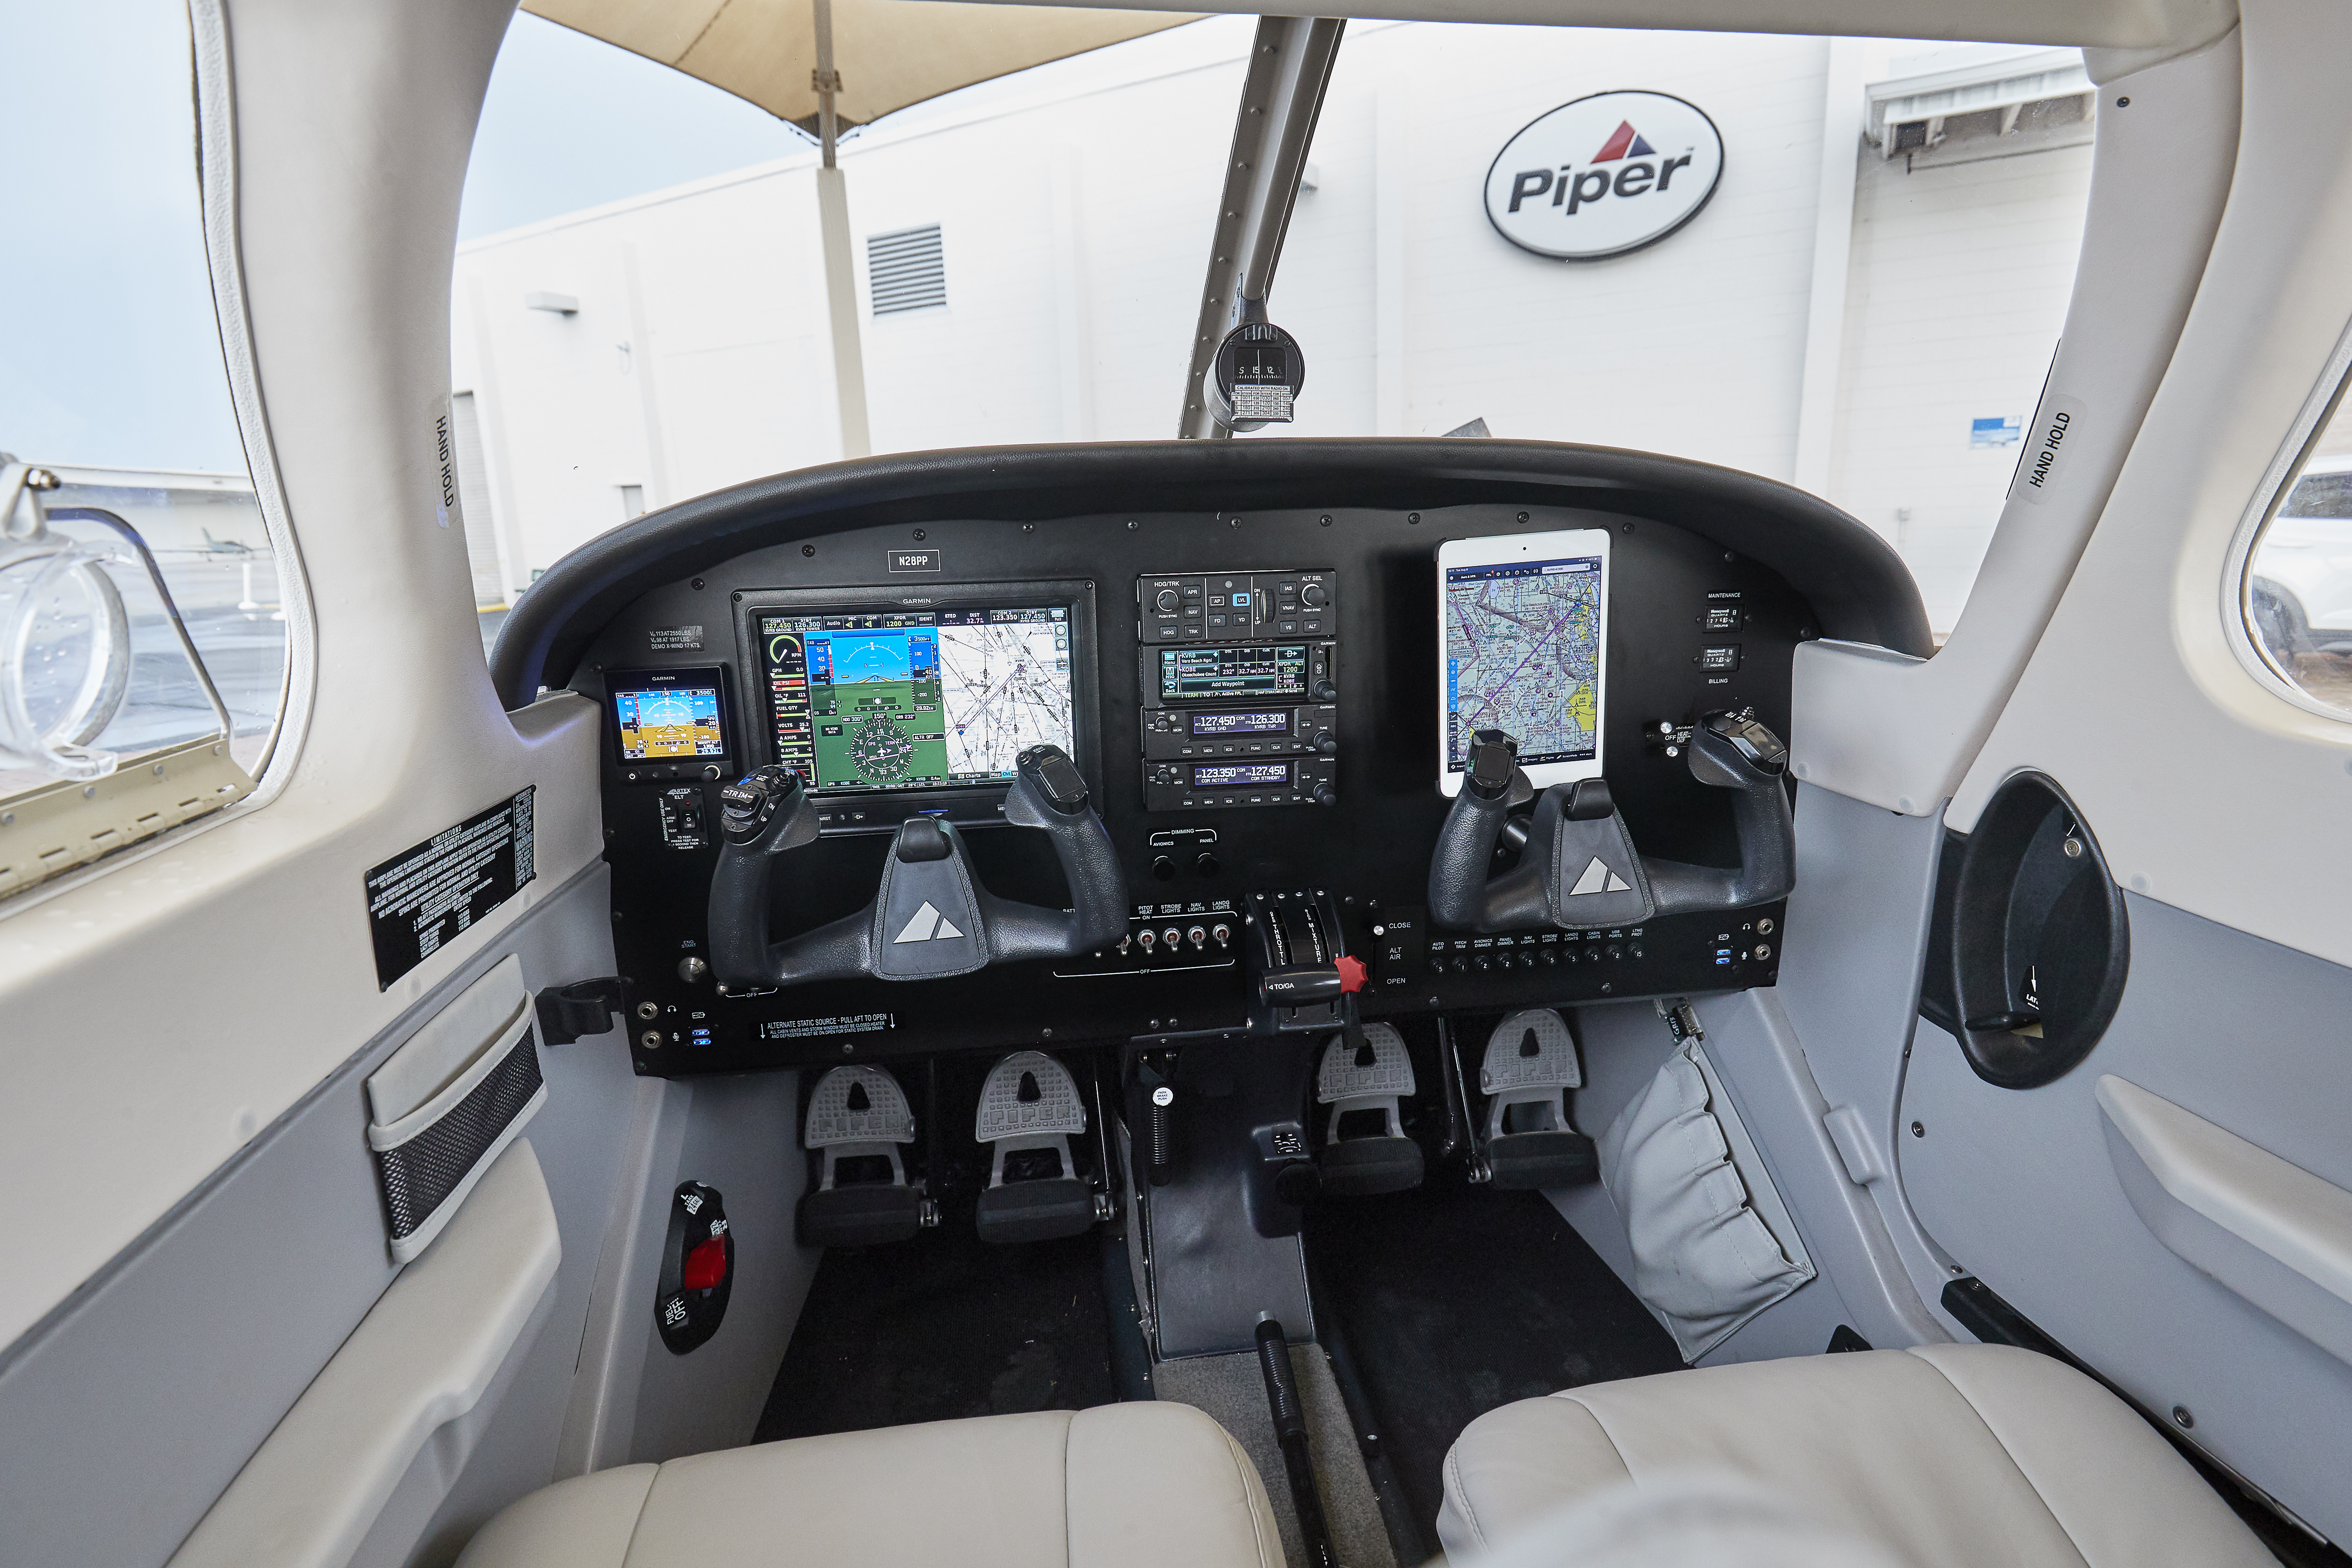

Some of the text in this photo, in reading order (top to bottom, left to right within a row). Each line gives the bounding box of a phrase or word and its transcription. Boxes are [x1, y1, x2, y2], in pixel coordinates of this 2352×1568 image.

[1508, 154, 1693, 215] Piper
[2029, 412, 2070, 488] HAND HOLD
[436, 415, 454, 507] HAND HOLD
[899, 556, 928, 566] N28PP
[1201, 716, 1236, 726] 127.450
[1250, 714, 1285, 724] 126.300
[1201, 768, 1236, 778] 123.350
[1251, 766, 1285, 776] 127.450
[728, 789, 748, 799] TRIM
[431, 825, 461, 846] LIMITATIONS
[515, 831, 533, 851] WARNING
[1308, 923, 1322, 964] MIXTURE
[768, 1021, 795, 1029] ALTERNATE
[684, 1194, 695, 1206] TANK
[688, 1204, 697, 1212] 24
[665, 1305, 674, 1325] FUEL
[672, 1299, 686, 1320] OFF
